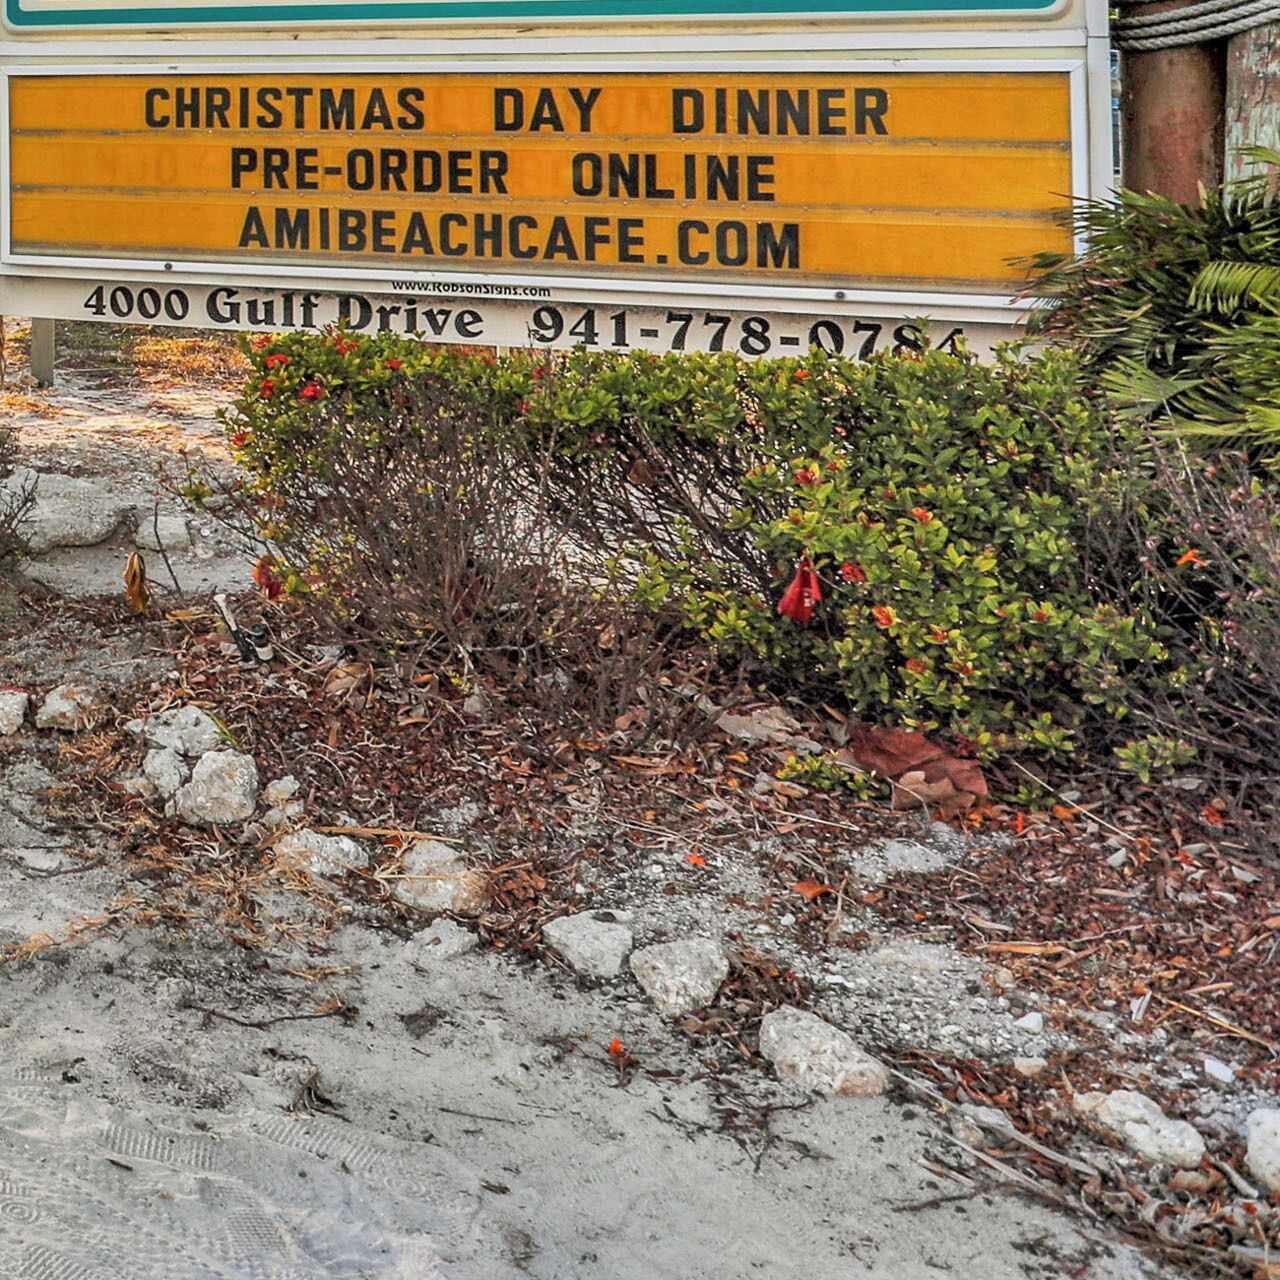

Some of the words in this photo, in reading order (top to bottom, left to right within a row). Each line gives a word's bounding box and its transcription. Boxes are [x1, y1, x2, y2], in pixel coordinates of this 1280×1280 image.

[144, 86, 426, 131] CHRISTMAS
[493, 87, 603, 132] DAY
[672, 87, 892, 136] DINNER
[231, 146, 510, 195] PRE-ORDER
[571, 151, 776, 202] ONLINE
[238, 205, 801, 270] AMIBEACHCAFE.COM
[83, 285, 190, 322] 4000
[206, 287, 322, 330] Gulf
[340, 293, 485, 340] Drive
